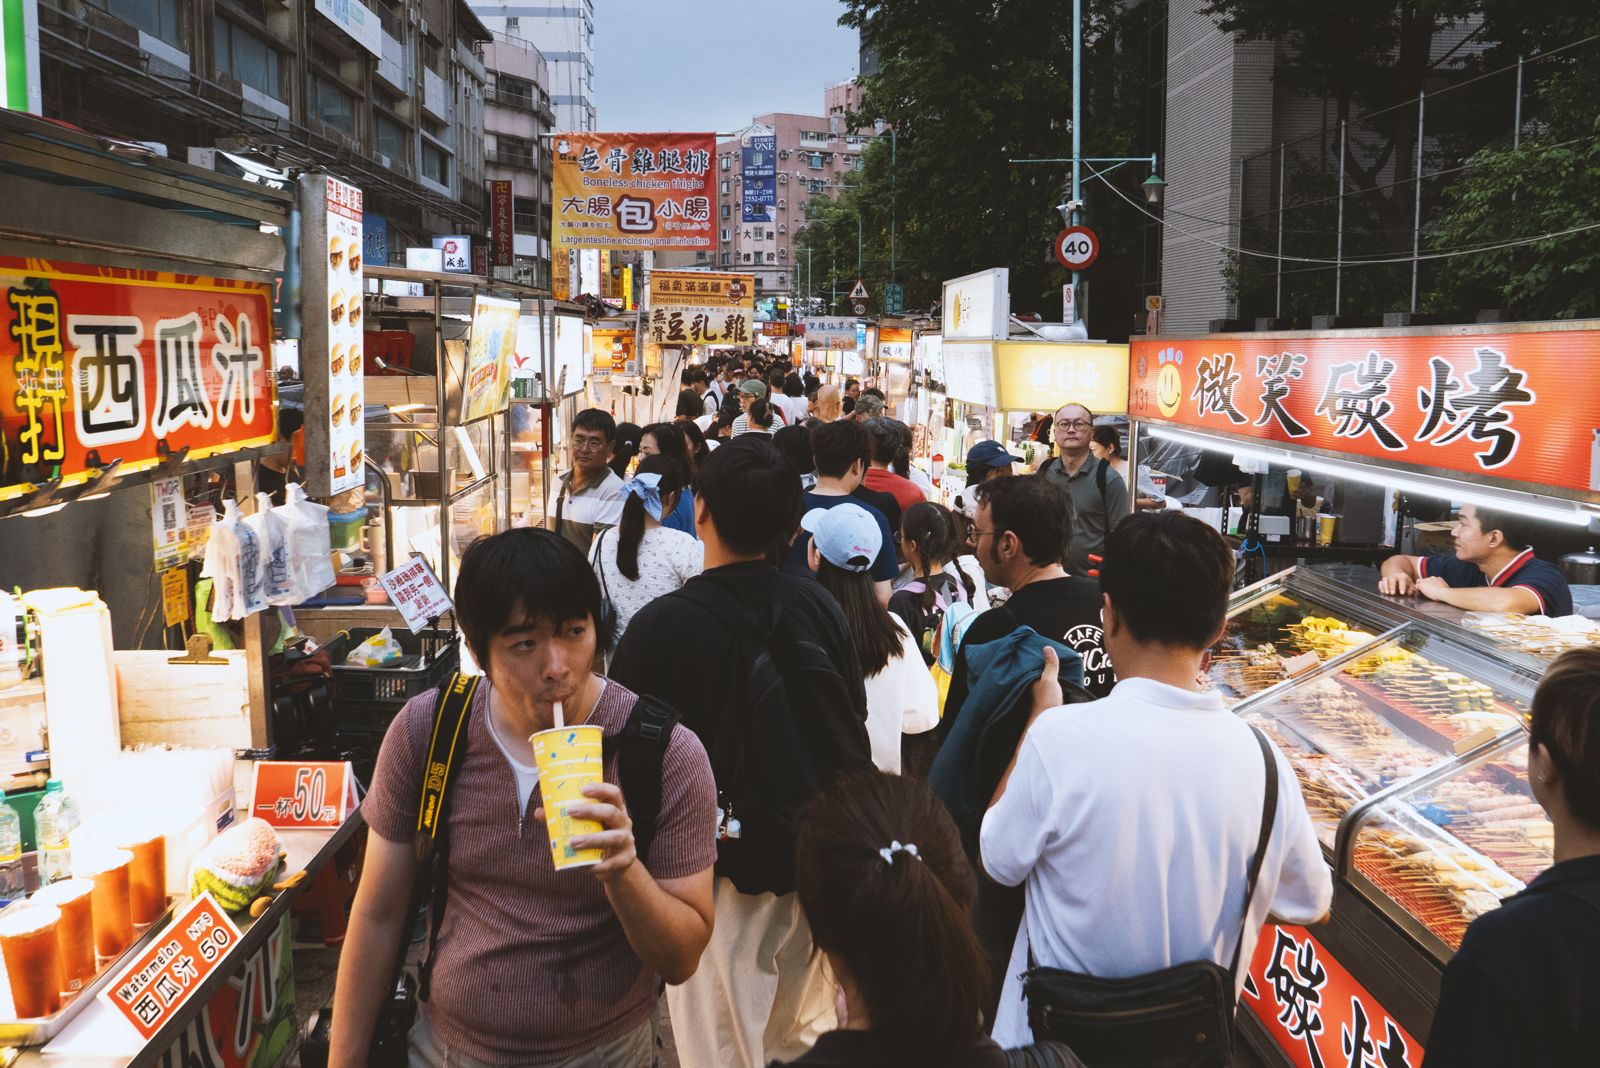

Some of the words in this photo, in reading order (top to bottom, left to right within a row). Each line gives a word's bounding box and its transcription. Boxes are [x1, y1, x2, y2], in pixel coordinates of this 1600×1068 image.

[578, 147, 710, 176] 無骨雞腿排
[583, 177, 628, 188] Boneless
[630, 178, 670, 189] chicken
[672, 178, 704, 191] thighs
[560, 235, 583, 245] Large
[583, 236, 616, 245] intestine
[617, 236, 653, 246] enclosing
[1064, 240, 1089, 256] 40
[666, 312, 749, 343] 豆乳雞
[831, 340, 846, 350] 30
[67, 312, 262, 448] 西瓜汁
[1134, 388, 1149, 411] 131
[1191, 346, 1537, 470] 微笑碳烤
[1067, 627, 1103, 645] CAFE
[427, 761, 446, 791] D5
[424, 794, 436, 828] Nikon
[116, 940, 183, 1004] Watermelon
[131, 956, 198, 1028] 西瓜汁
[198, 927, 231, 963] 50
